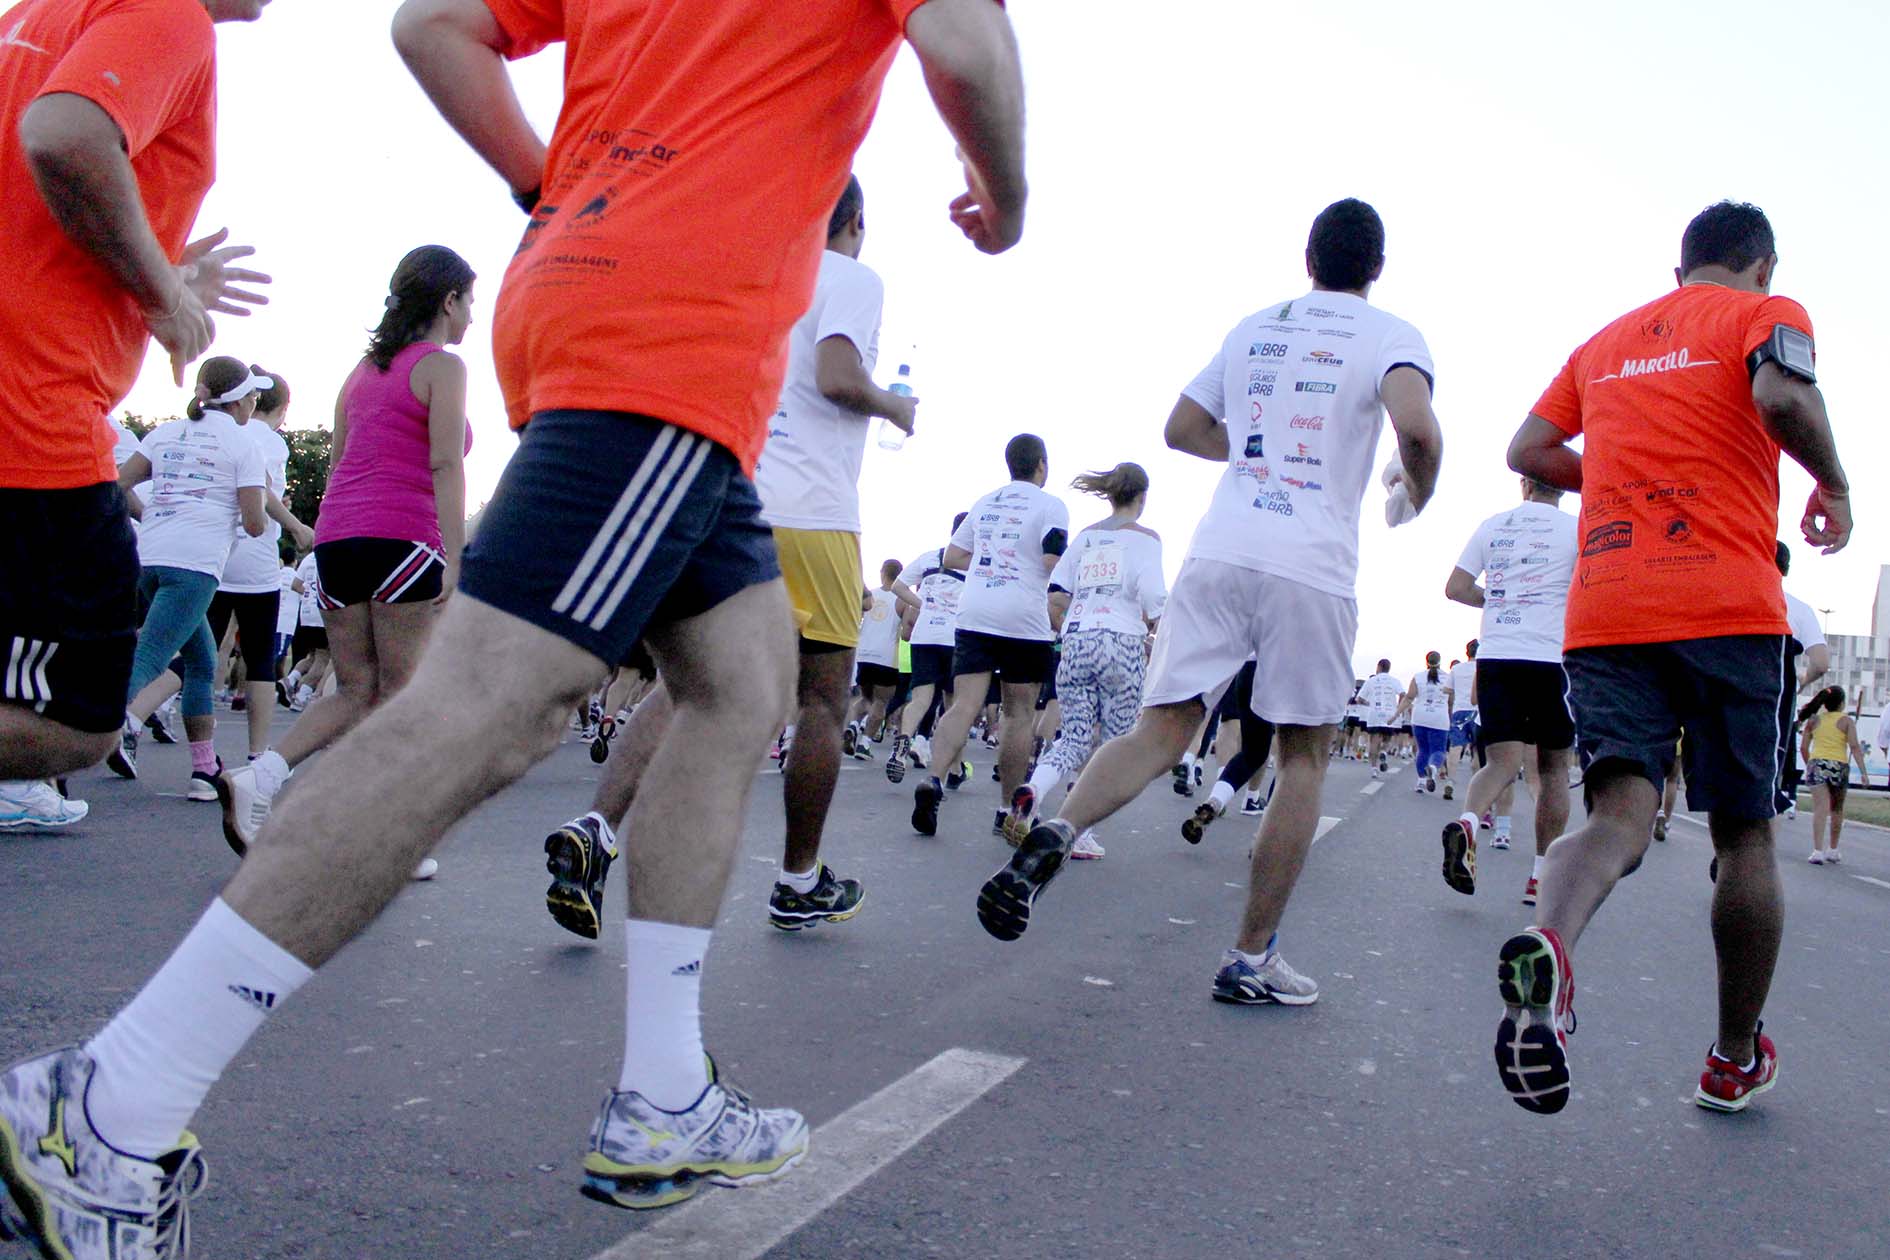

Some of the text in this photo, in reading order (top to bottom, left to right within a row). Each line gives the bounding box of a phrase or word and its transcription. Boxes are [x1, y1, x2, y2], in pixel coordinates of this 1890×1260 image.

[1261, 343, 1288, 357] BRB
[1619, 347, 1689, 379] MARCELO
[1253, 382, 1274, 396] BRB
[1307, 383, 1332, 393] FIBRA
[1284, 454, 1306, 463] Super
[1267, 500, 1293, 516] BRB
[1083, 561, 1118, 581] 7333
[1504, 616, 1522, 625] BRB
